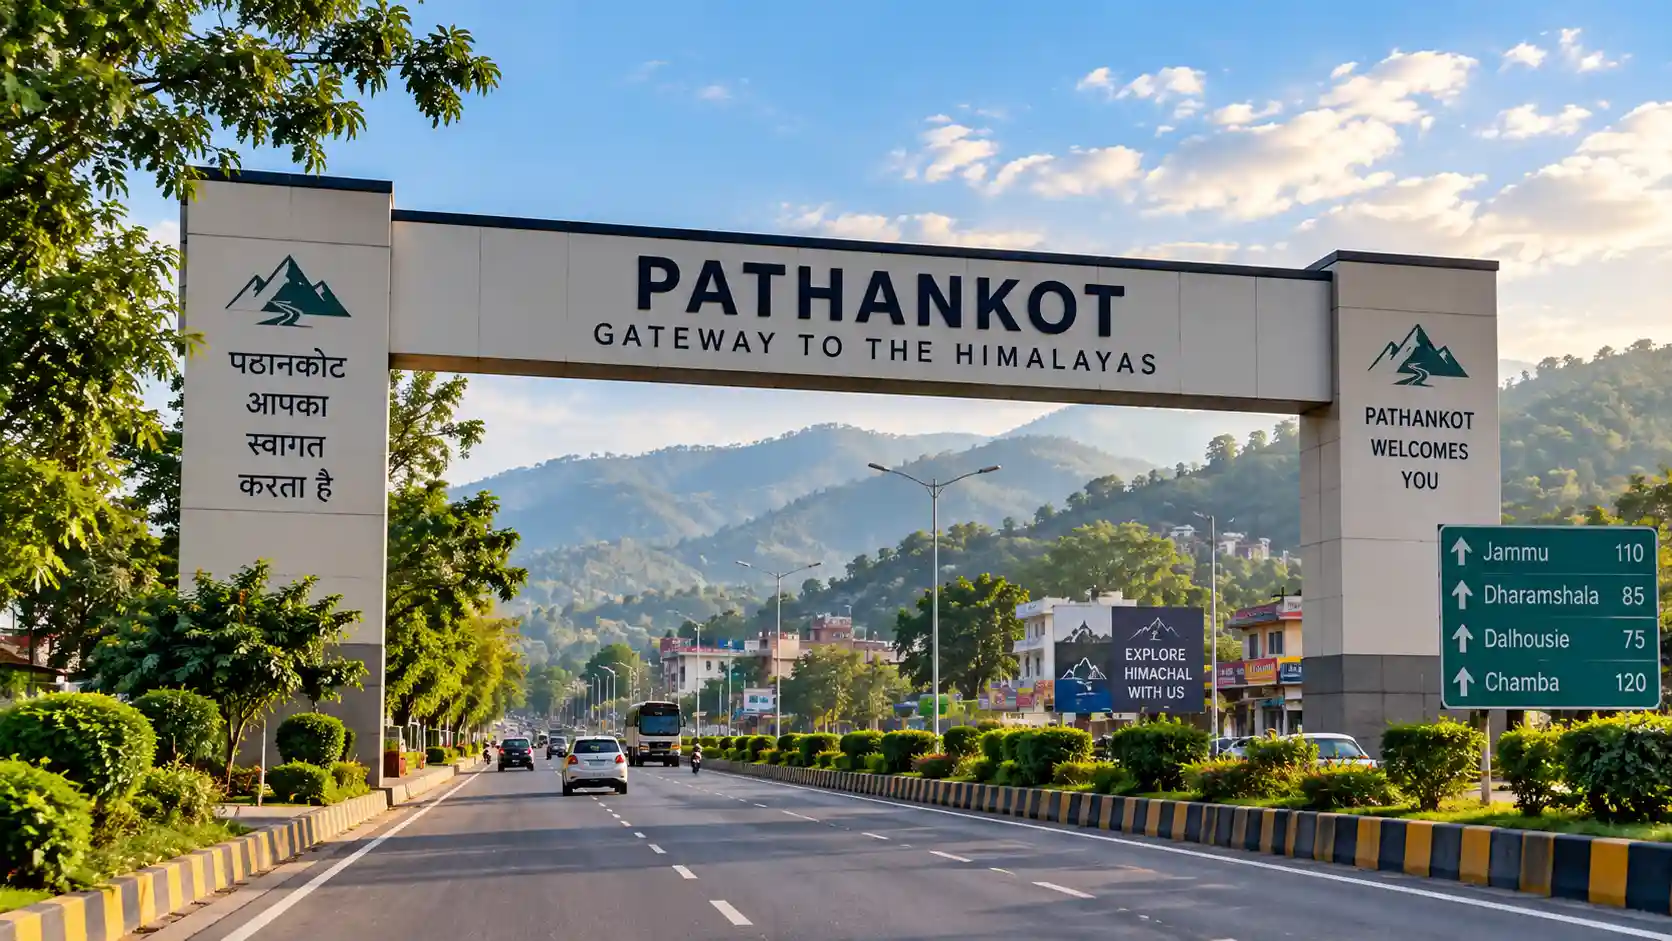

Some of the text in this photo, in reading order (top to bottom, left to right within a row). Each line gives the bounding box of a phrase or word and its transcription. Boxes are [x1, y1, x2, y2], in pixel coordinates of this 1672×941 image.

[637, 255, 1125, 337] PATHANKOT
[594, 322, 1157, 375] GATEWAY TO THE HIMALAYAS
[228, 348, 347, 378] पठानकोट
[246, 392, 329, 417] आपका
[1366, 407, 1474, 429] PATHANKOT
[246, 433, 326, 458] स्वागत
[1371, 439, 1468, 460] WELCOMES
[238, 468, 333, 502] करता है
[1401, 471, 1439, 490] YOU
[1483, 541, 1644, 563] Jammu 110
[1484, 584, 1645, 606] Dharamshala 85
[1484, 628, 1645, 649] Dalhousie 75
[1125, 648, 1186, 661] EXPLORE
[1124, 667, 1192, 680] HIMACHAL
[1485, 671, 1647, 692] Chamba 120
[1128, 686, 1185, 699] WITH US
